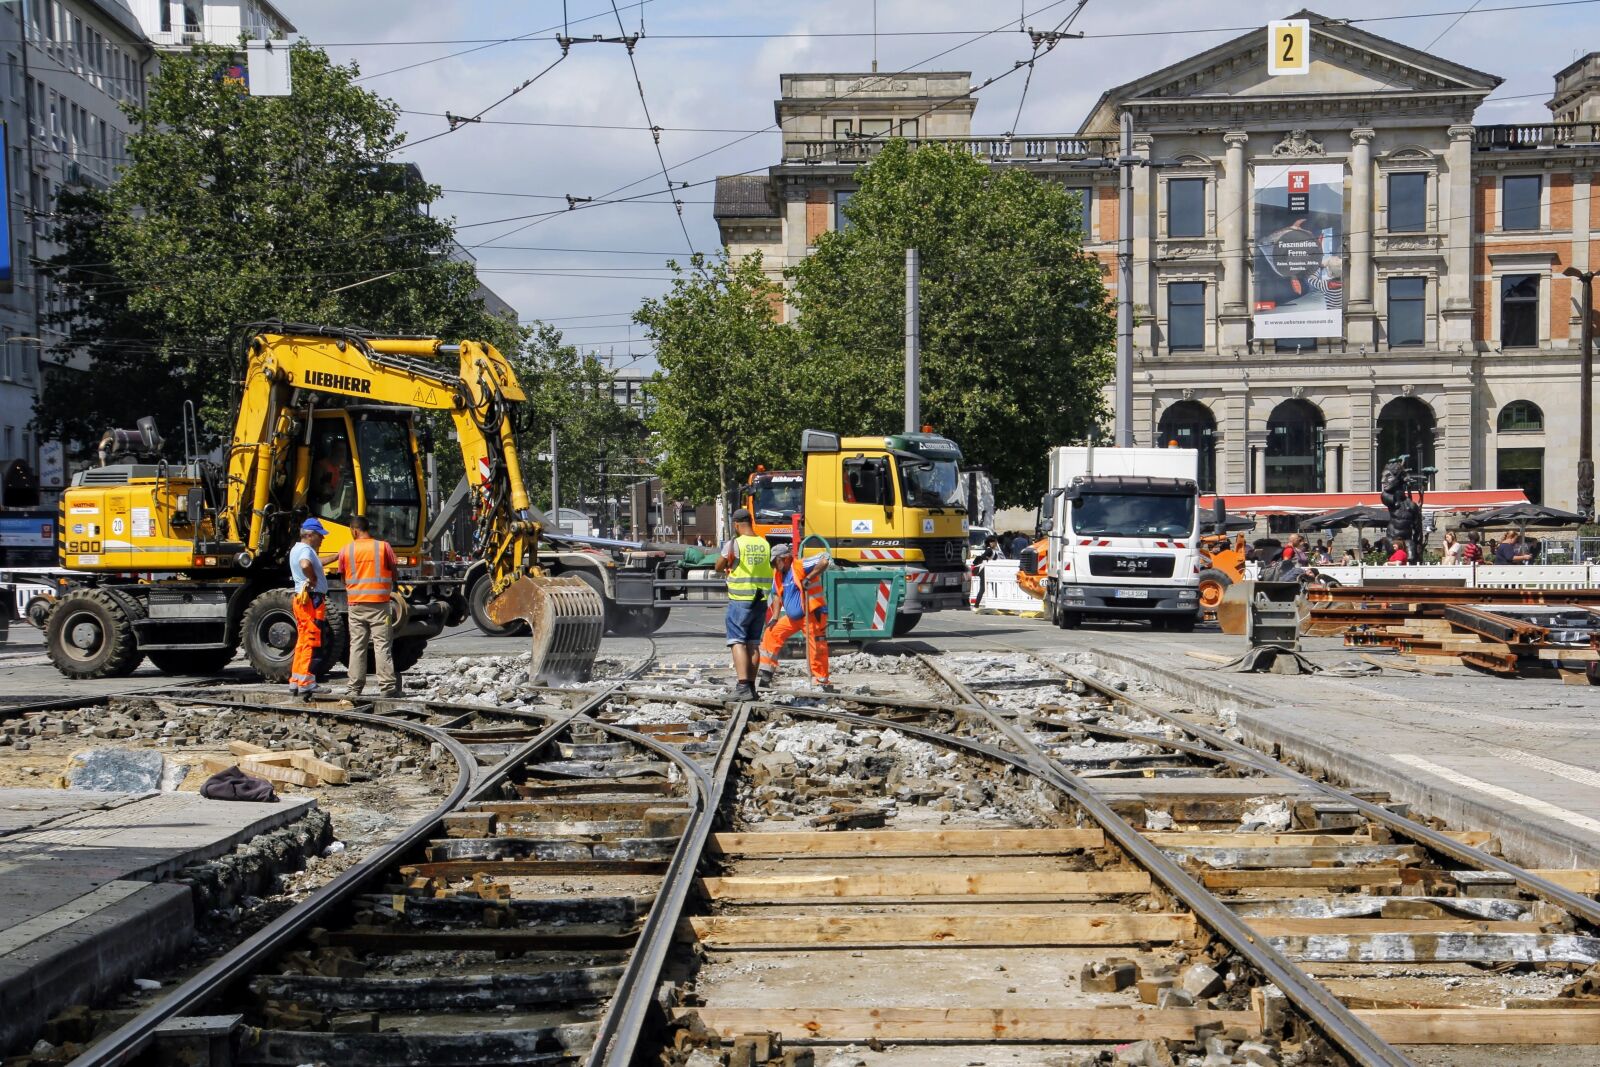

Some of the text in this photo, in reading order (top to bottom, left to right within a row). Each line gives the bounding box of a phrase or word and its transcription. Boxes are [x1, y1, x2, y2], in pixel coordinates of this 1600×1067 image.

[1282, 33, 1294, 62] 2
[304, 369, 371, 394] LIEBHERR
[114, 520, 122, 532] 20
[69, 541, 100, 553] 900
[745, 544, 766, 553] SIPO
[1116, 560, 1148, 568] MAN
